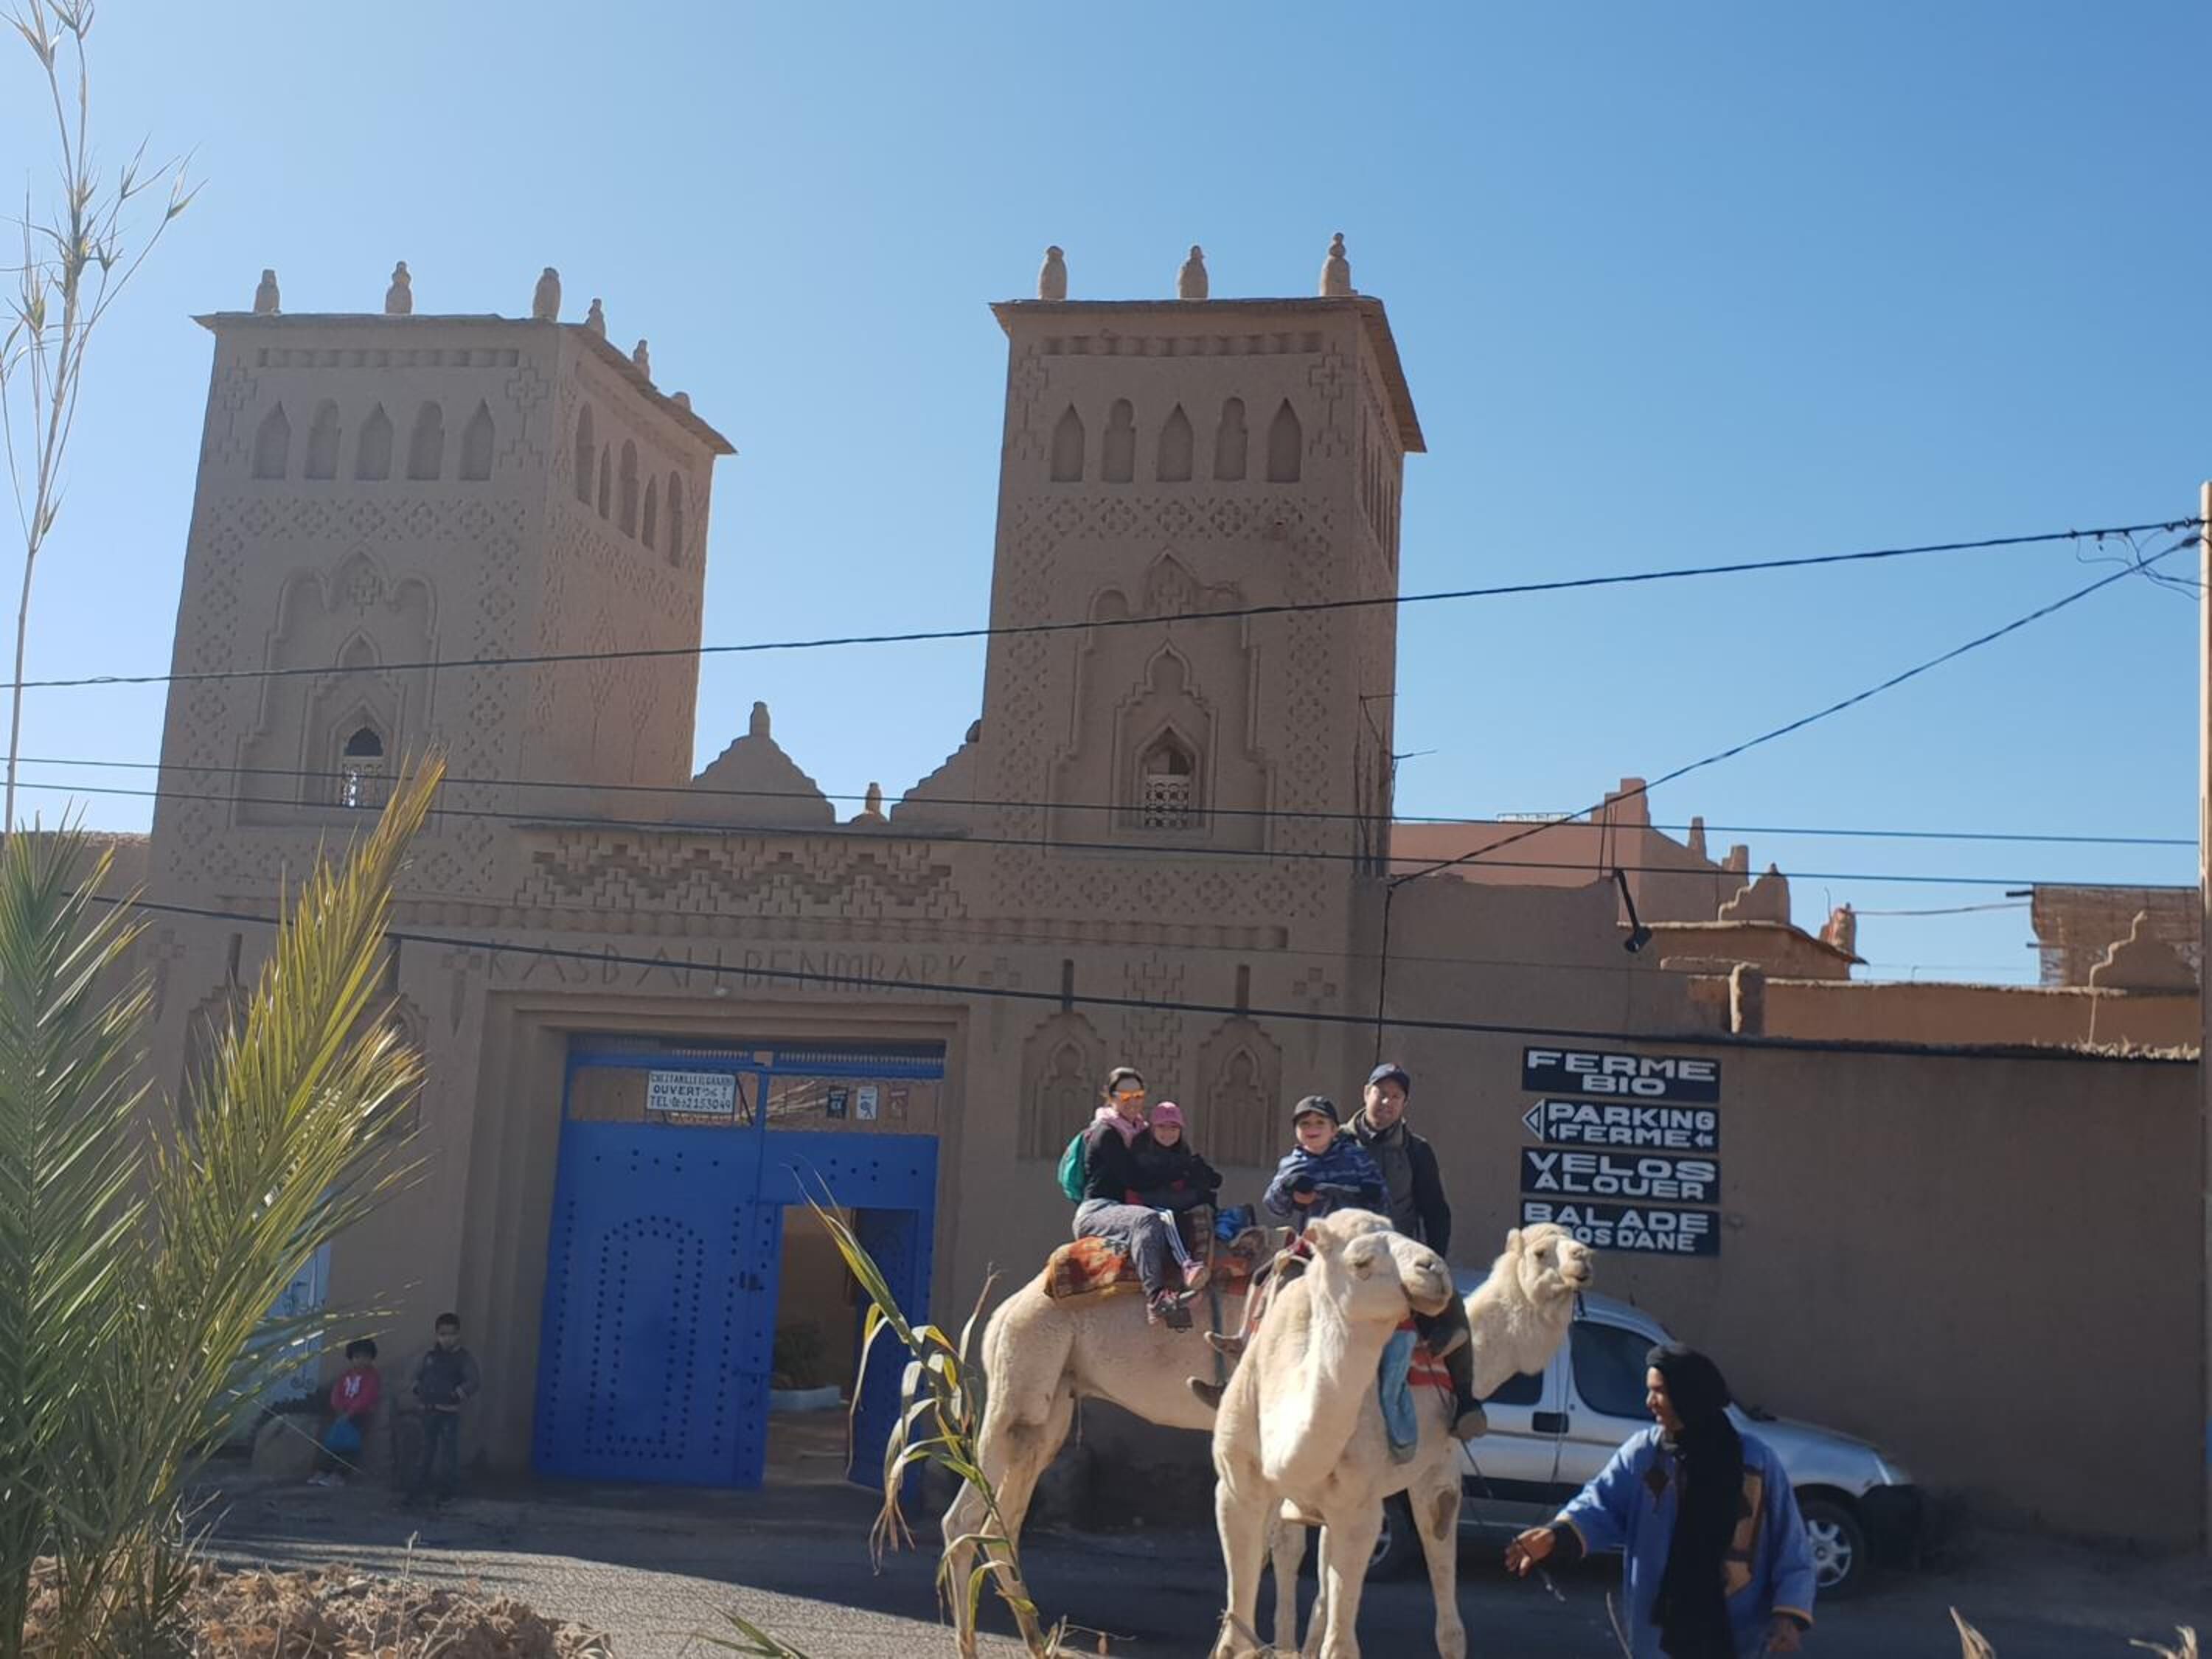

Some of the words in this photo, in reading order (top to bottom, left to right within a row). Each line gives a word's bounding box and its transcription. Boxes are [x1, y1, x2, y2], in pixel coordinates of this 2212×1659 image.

[1528, 1050, 1716, 1082] FERME
[653, 1085, 700, 1096] OUVERT
[1582, 1074, 1666, 1096] BIO
[1548, 1102, 1716, 1130] PARKING
[1559, 1124, 1691, 1147] FERME
[1528, 1152, 1716, 1182] VELOS
[1524, 1202, 1709, 1234] BALADE
